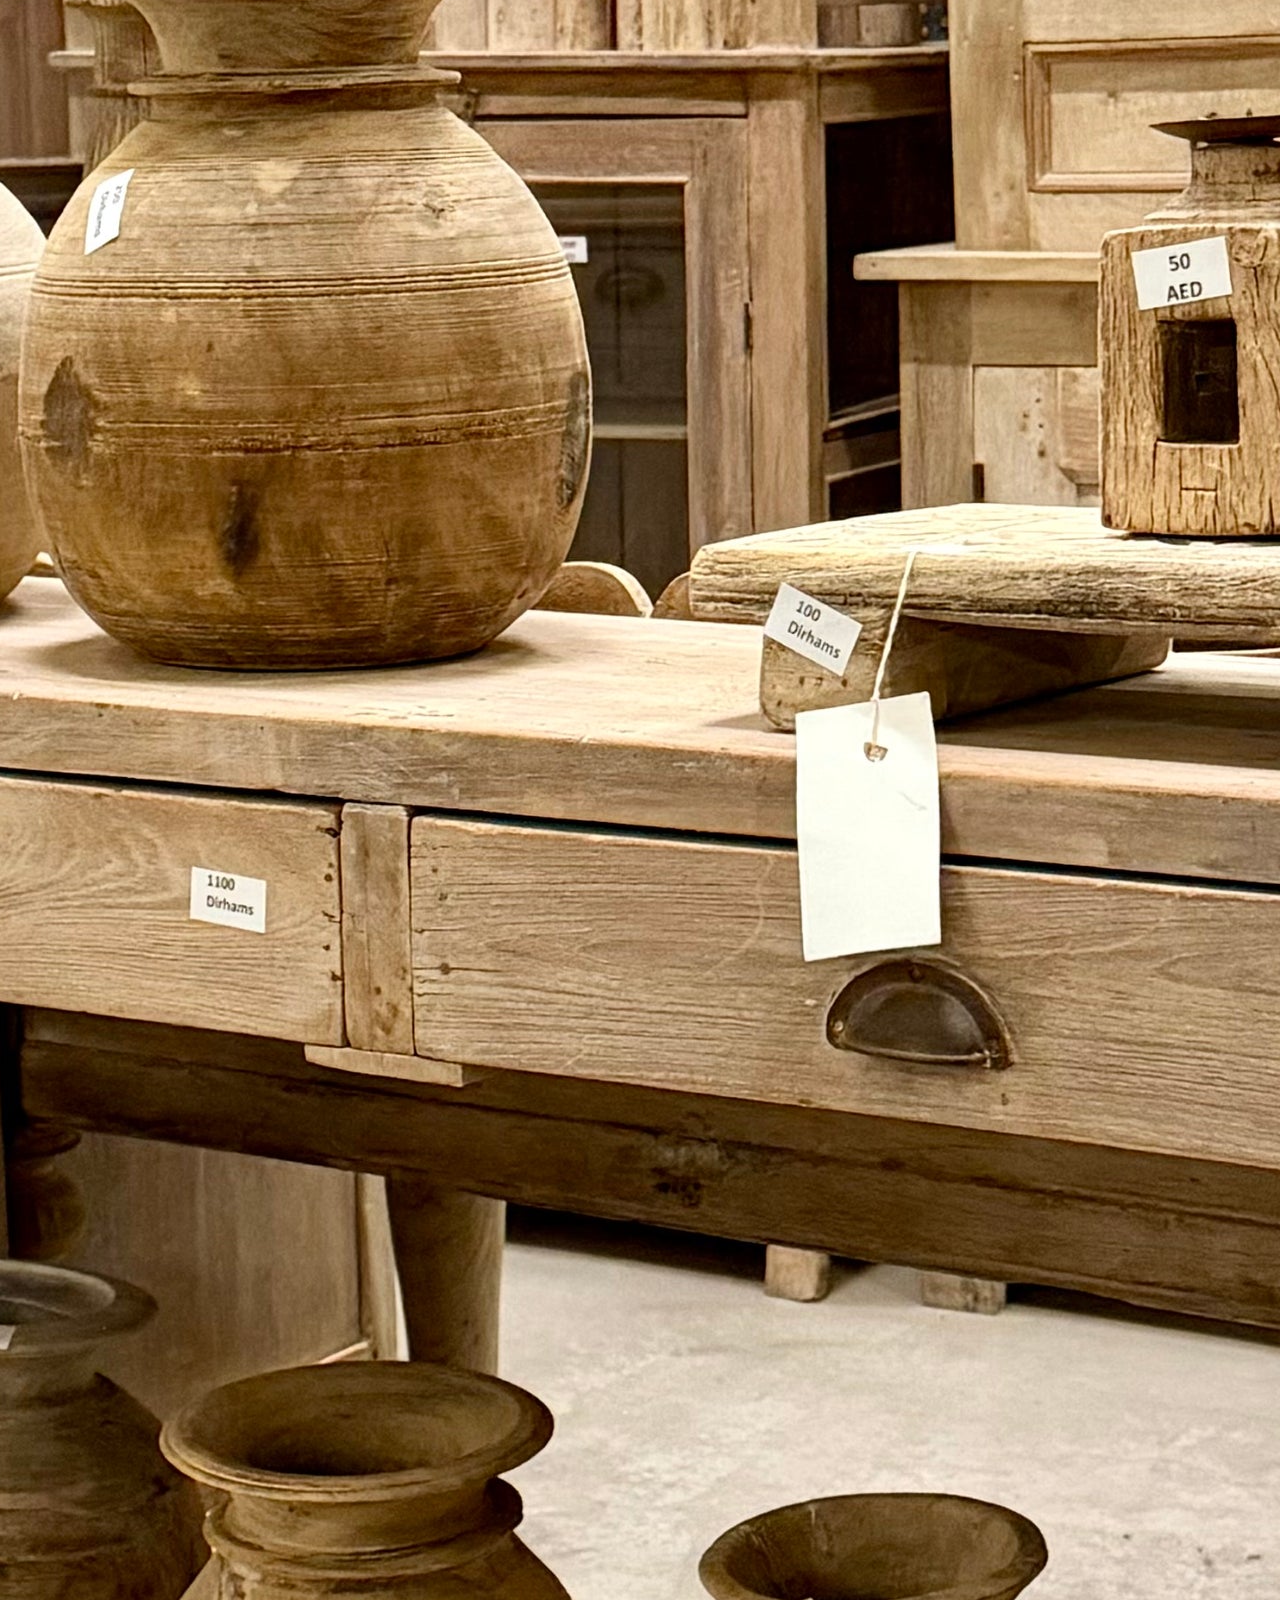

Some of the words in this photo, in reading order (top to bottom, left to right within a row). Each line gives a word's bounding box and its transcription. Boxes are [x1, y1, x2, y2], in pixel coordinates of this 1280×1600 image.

[1168, 252, 1191, 272] 50
[1167, 281, 1203, 302] AED
[795, 600, 822, 622] 100
[787, 620, 842, 659] Dirhams
[207, 874, 236, 891] 1100
[206, 894, 255, 916] Dirhams
